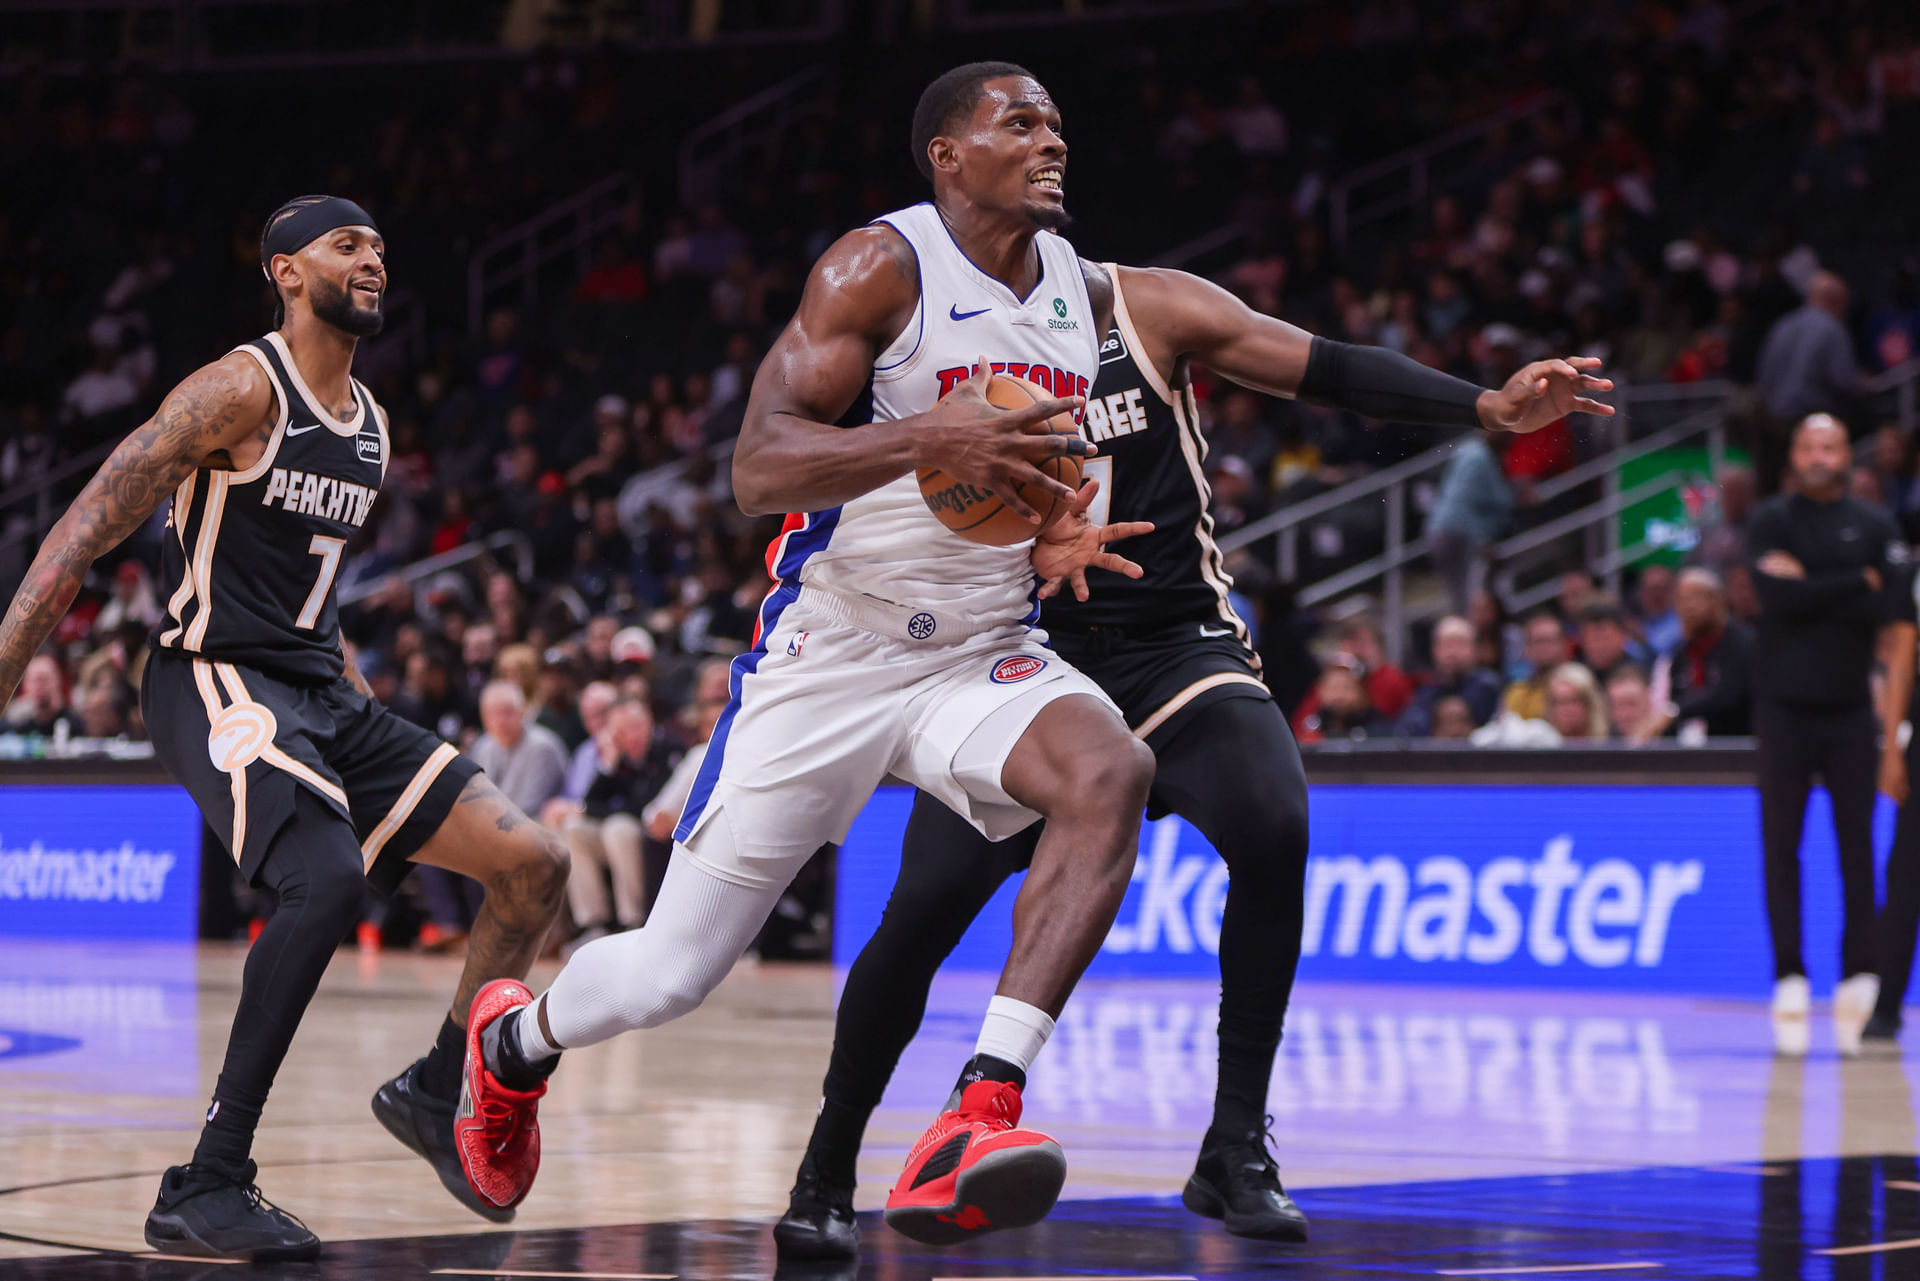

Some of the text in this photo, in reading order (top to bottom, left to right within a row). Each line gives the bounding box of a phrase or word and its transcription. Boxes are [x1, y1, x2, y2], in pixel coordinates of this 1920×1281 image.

[1047, 319, 1079, 331] StockX
[936, 362, 1090, 427] PONS
[358, 439, 380, 453] paze
[261, 467, 379, 528] PEACHTRE
[295, 534, 347, 631] 7
[0, 838, 177, 902] etmaster
[1097, 815, 1703, 968] ckemaster
